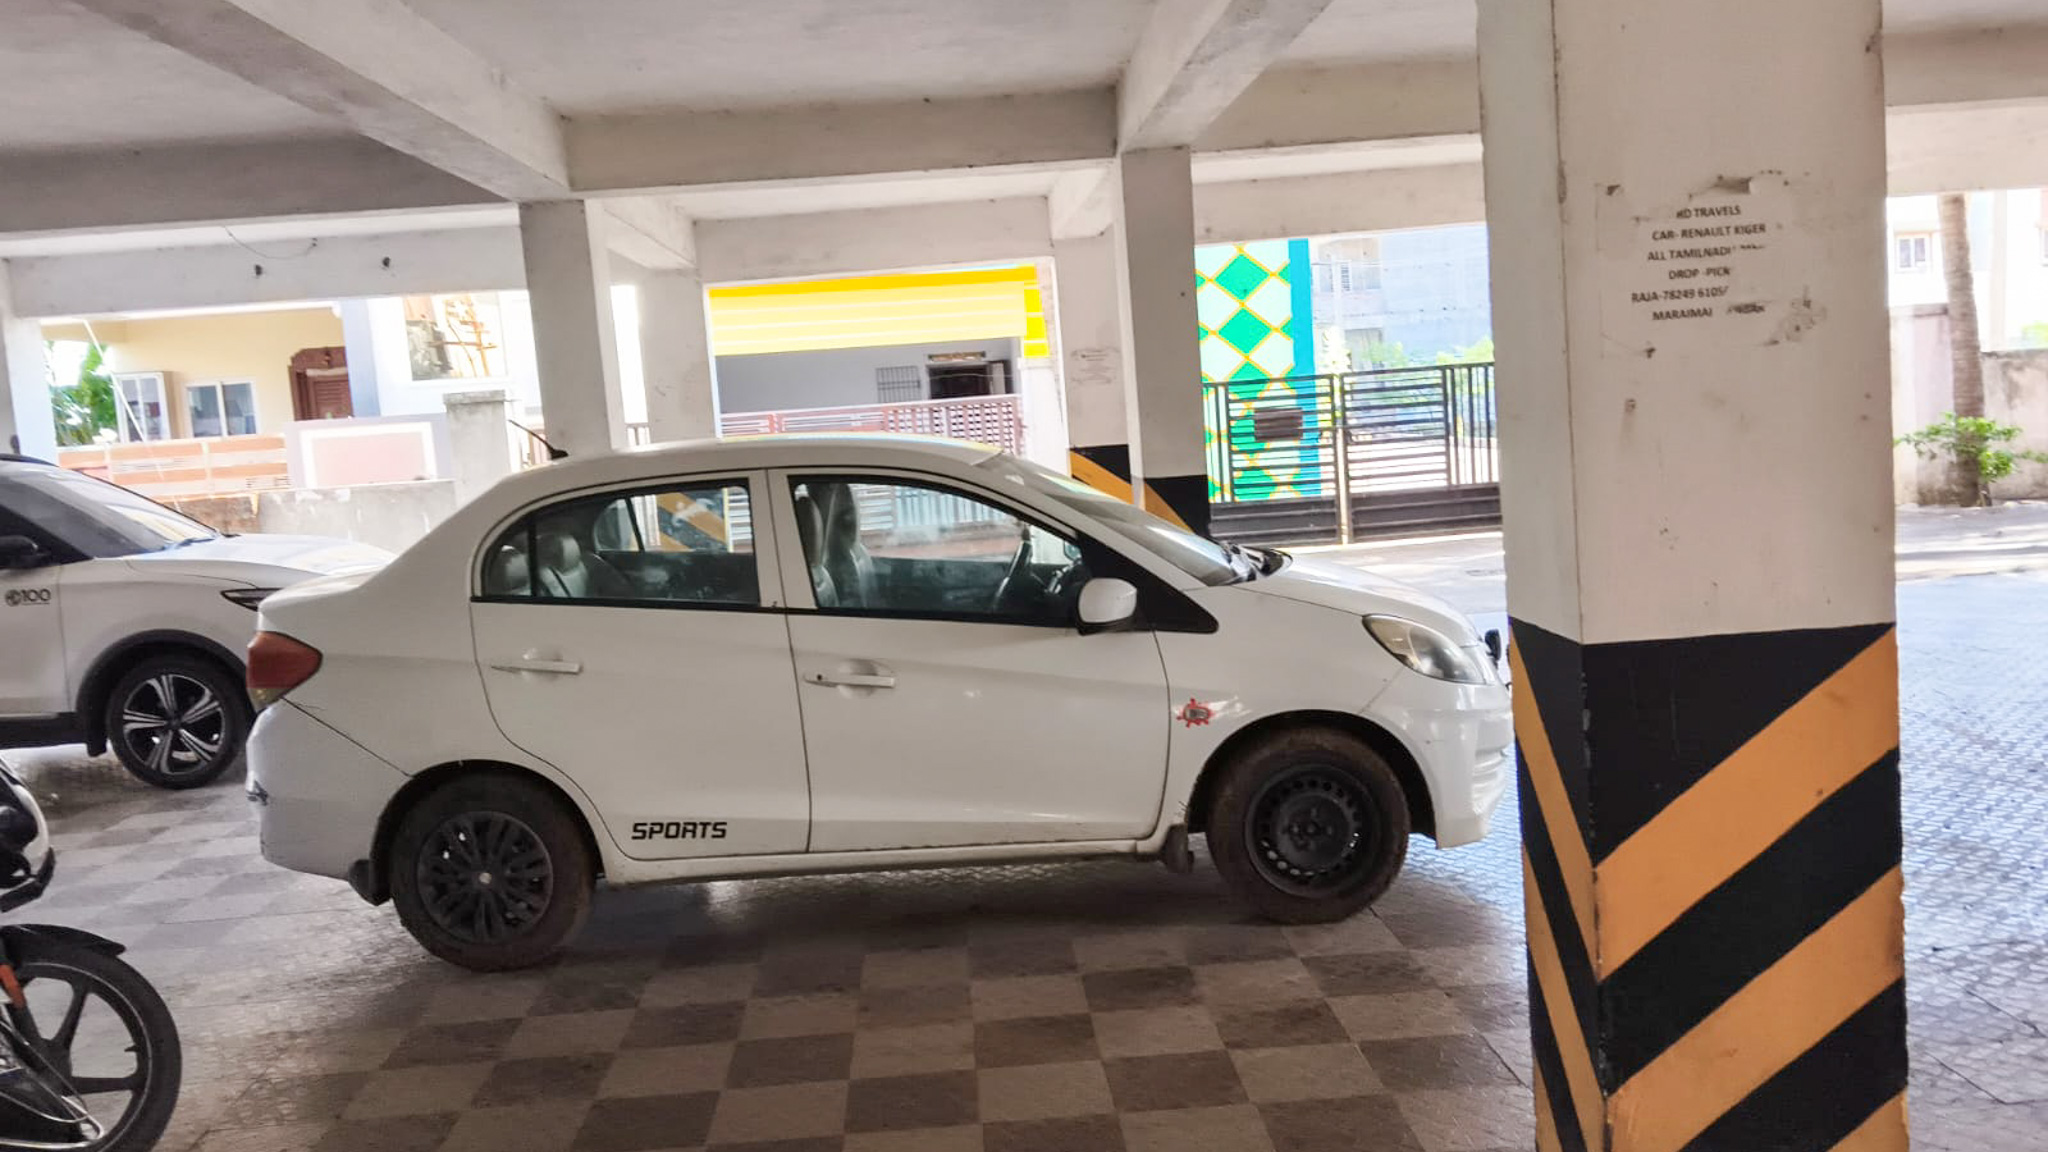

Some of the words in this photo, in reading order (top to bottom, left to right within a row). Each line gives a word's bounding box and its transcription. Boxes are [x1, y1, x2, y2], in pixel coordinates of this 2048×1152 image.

[1694, 205, 1741, 218] TRAVELS
[1681, 226, 1731, 239] RENAULT
[1648, 250, 1667, 261] ALL
[1668, 268, 1700, 280] DROP
[631, 821, 728, 840] SPORTS
